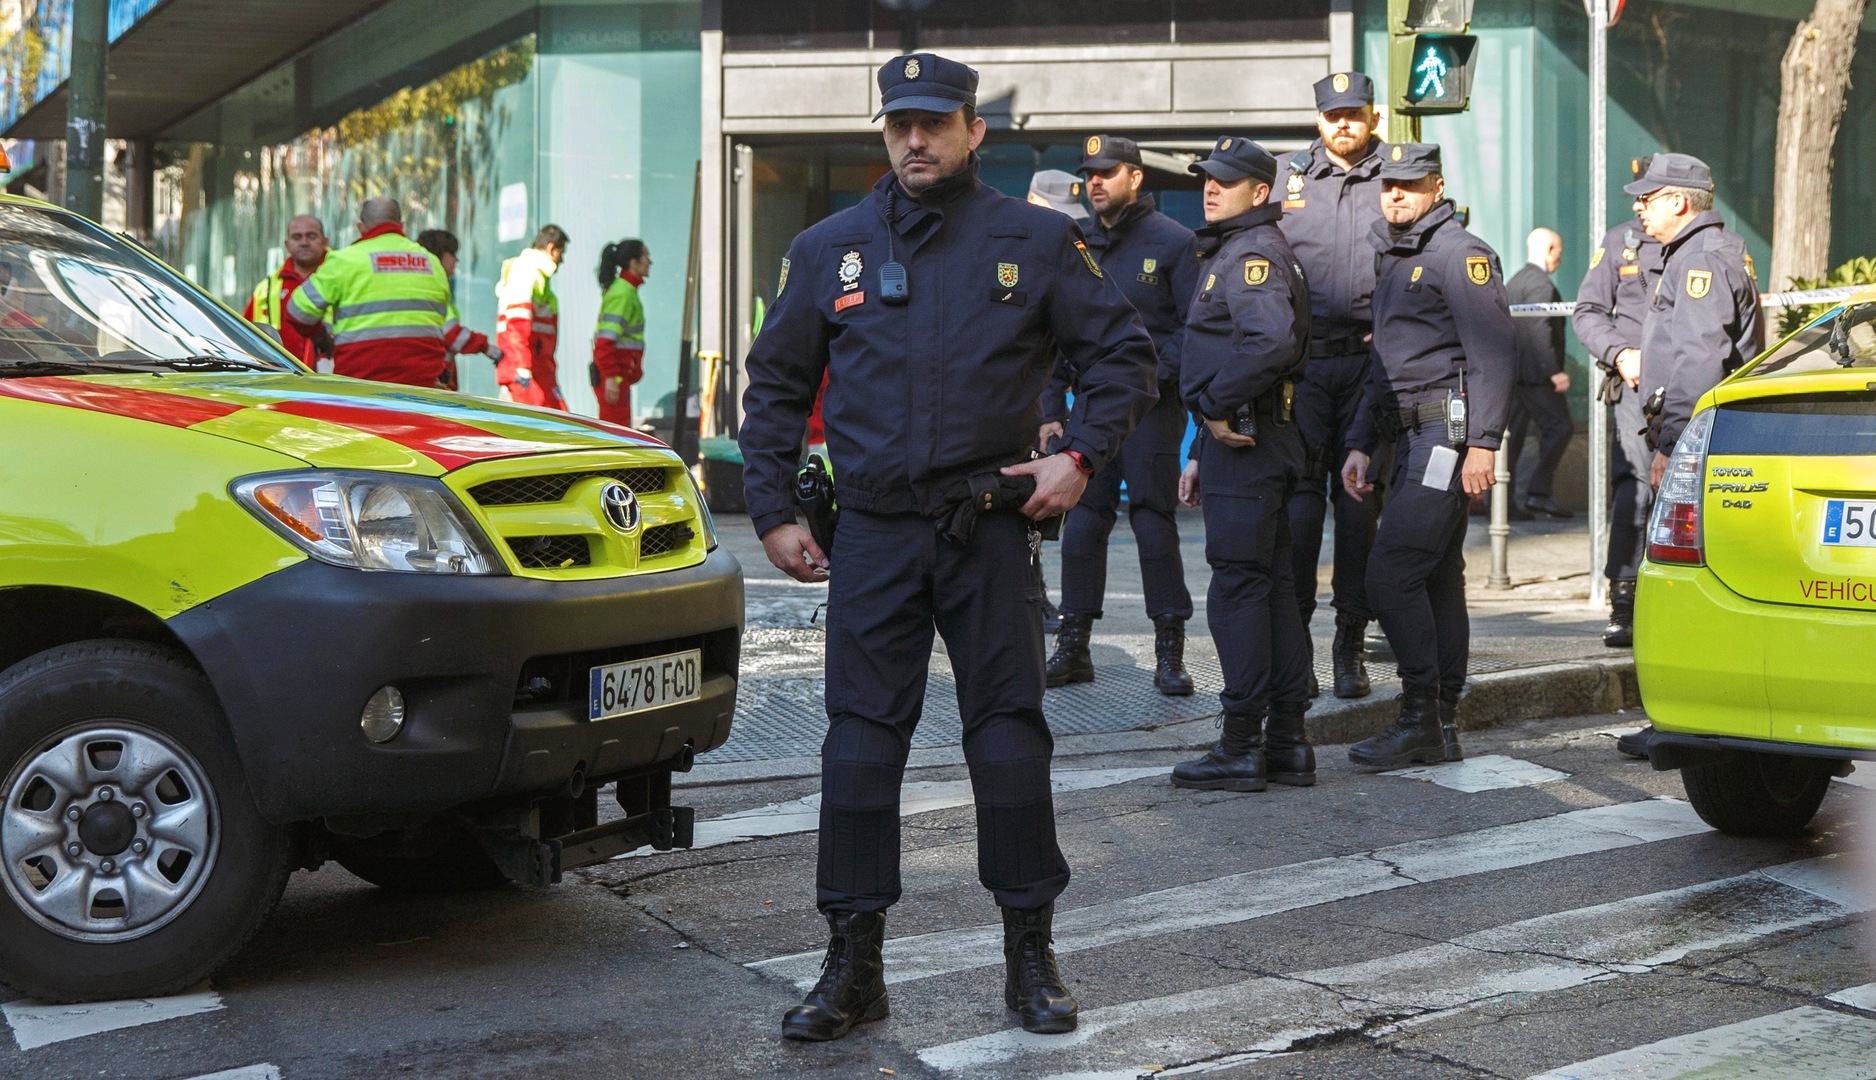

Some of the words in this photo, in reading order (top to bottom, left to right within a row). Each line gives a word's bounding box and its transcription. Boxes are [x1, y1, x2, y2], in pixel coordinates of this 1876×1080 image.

[1712, 467, 1754, 477] TOYOTA
[1708, 482, 1769, 493] PRIUS
[1828, 527, 1837, 537] E
[593, 699, 599, 710] E
[603, 665, 655, 711] 6478
[662, 658, 695, 701] FCD
